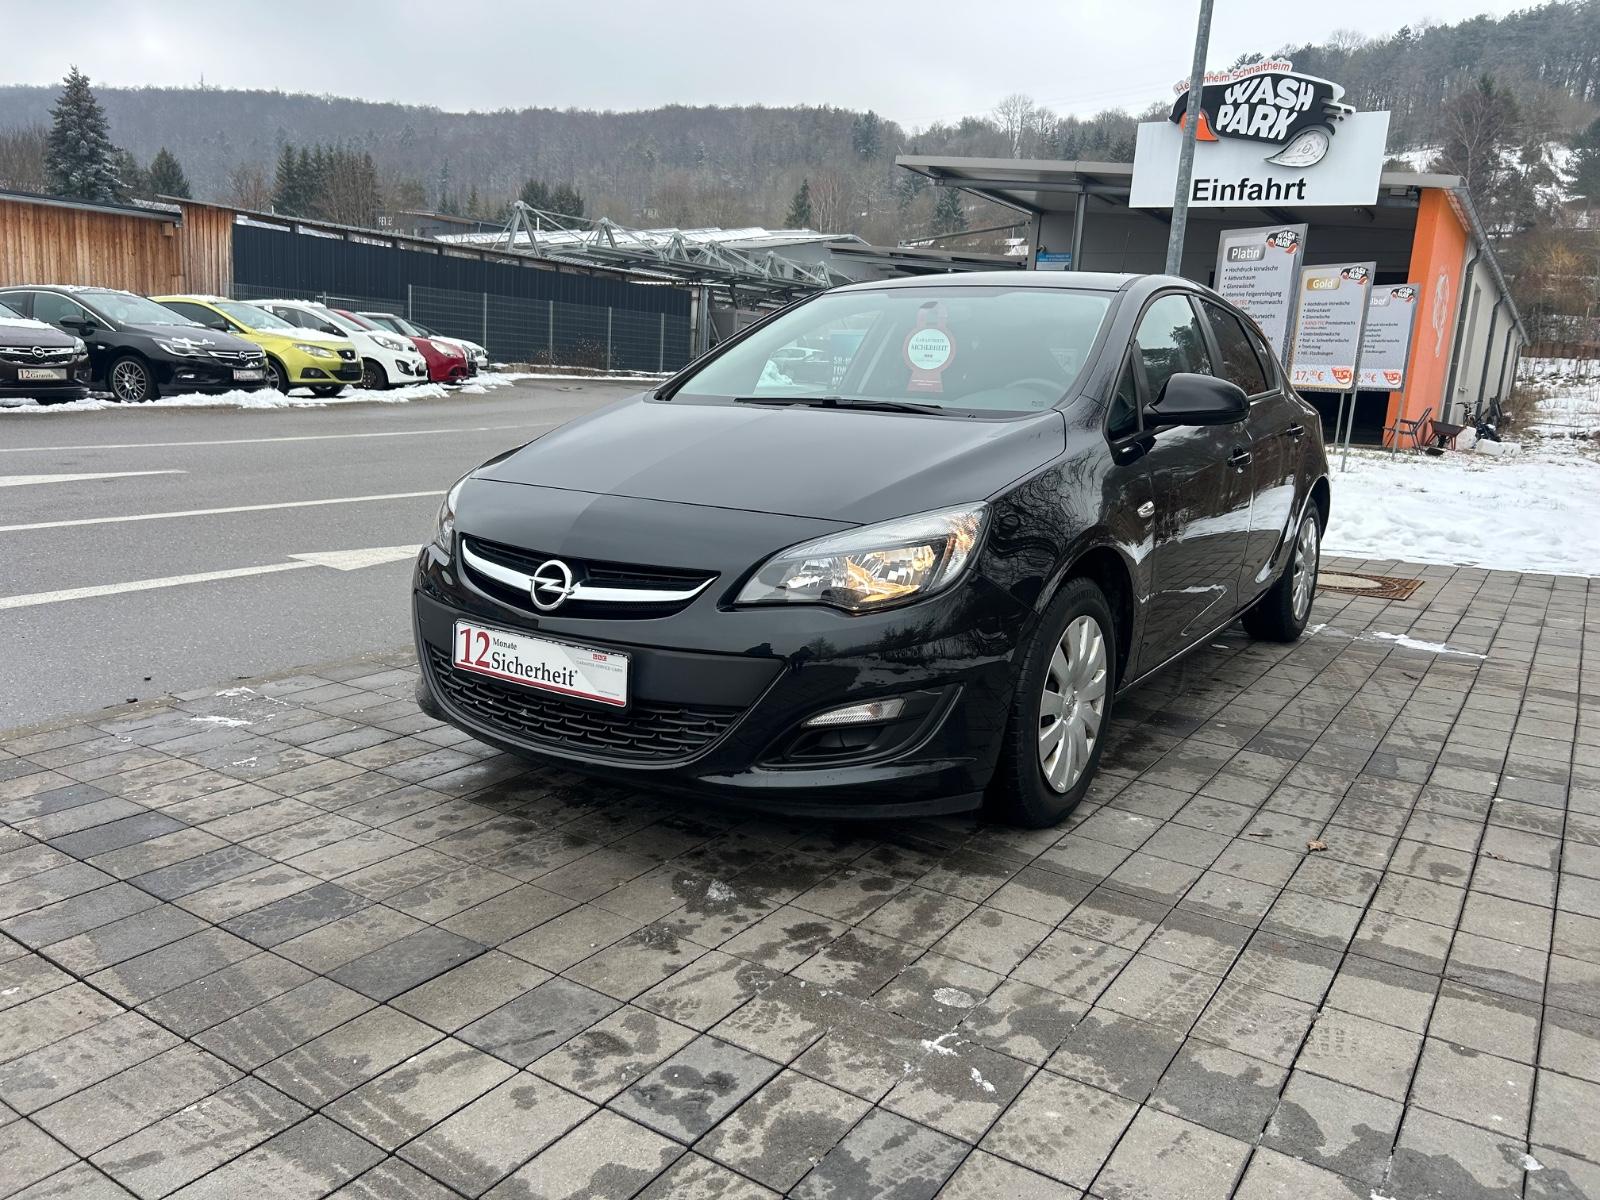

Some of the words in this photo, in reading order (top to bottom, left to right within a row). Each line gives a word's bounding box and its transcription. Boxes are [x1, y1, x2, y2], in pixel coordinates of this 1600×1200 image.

[1176, 73, 1230, 95] Henheim
[1232, 61, 1290, 80] Schnaitheim
[1224, 76, 1314, 111] WASH
[1216, 103, 1298, 140] PARK
[1191, 177, 1307, 201] Einfahrt
[1231, 246, 1260, 260] Platin
[1312, 279, 1333, 288] Gold
[459, 628, 490, 669] 12
[492, 637, 518, 650] Monate
